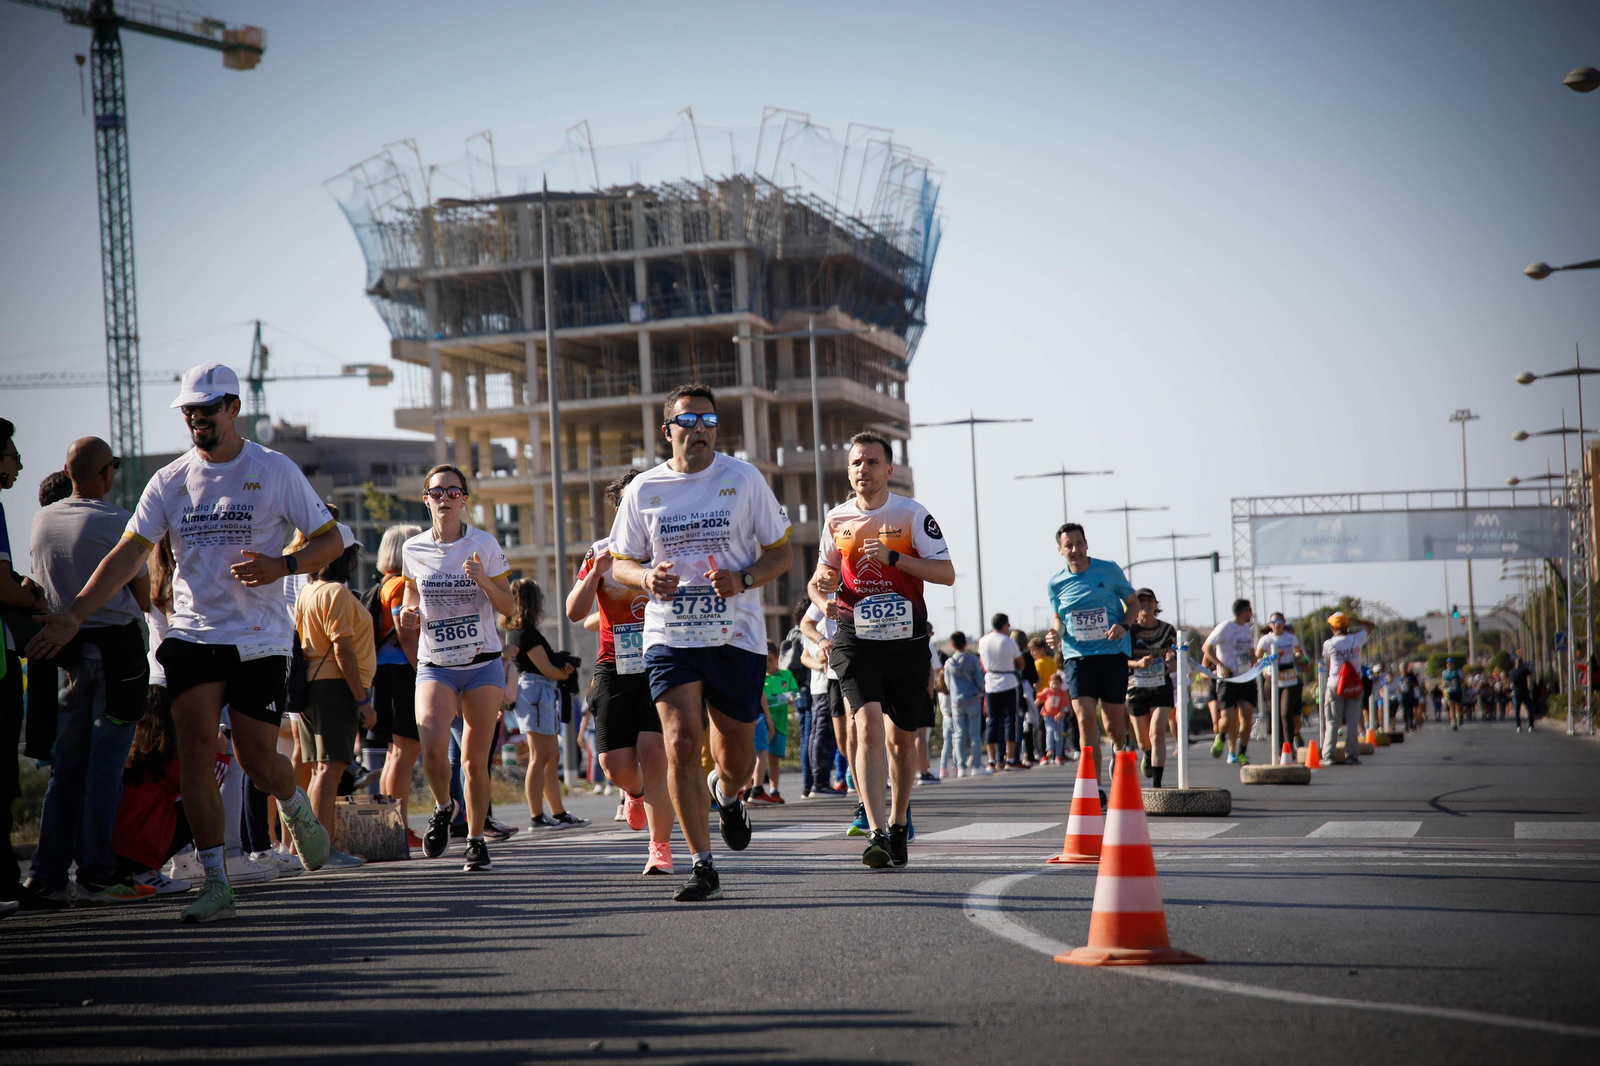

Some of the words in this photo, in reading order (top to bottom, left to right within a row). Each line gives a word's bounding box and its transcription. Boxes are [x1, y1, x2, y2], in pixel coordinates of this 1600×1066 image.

[182, 504, 210, 514] Medio
[212, 503, 254, 511] Maratón
[181, 512, 218, 524] Almería
[220, 511, 252, 521] 2024
[658, 513, 686, 524] Medio
[690, 508, 730, 519] Maratón
[660, 520, 700, 534] Almería
[702, 518, 730, 528] 2024
[662, 534, 684, 542] RAMÓN
[421, 580, 452, 588] Almería
[672, 596, 727, 614] 5738
[861, 602, 906, 620] 5625
[1076, 614, 1104, 625] 5756
[435, 624, 478, 642] 5866
